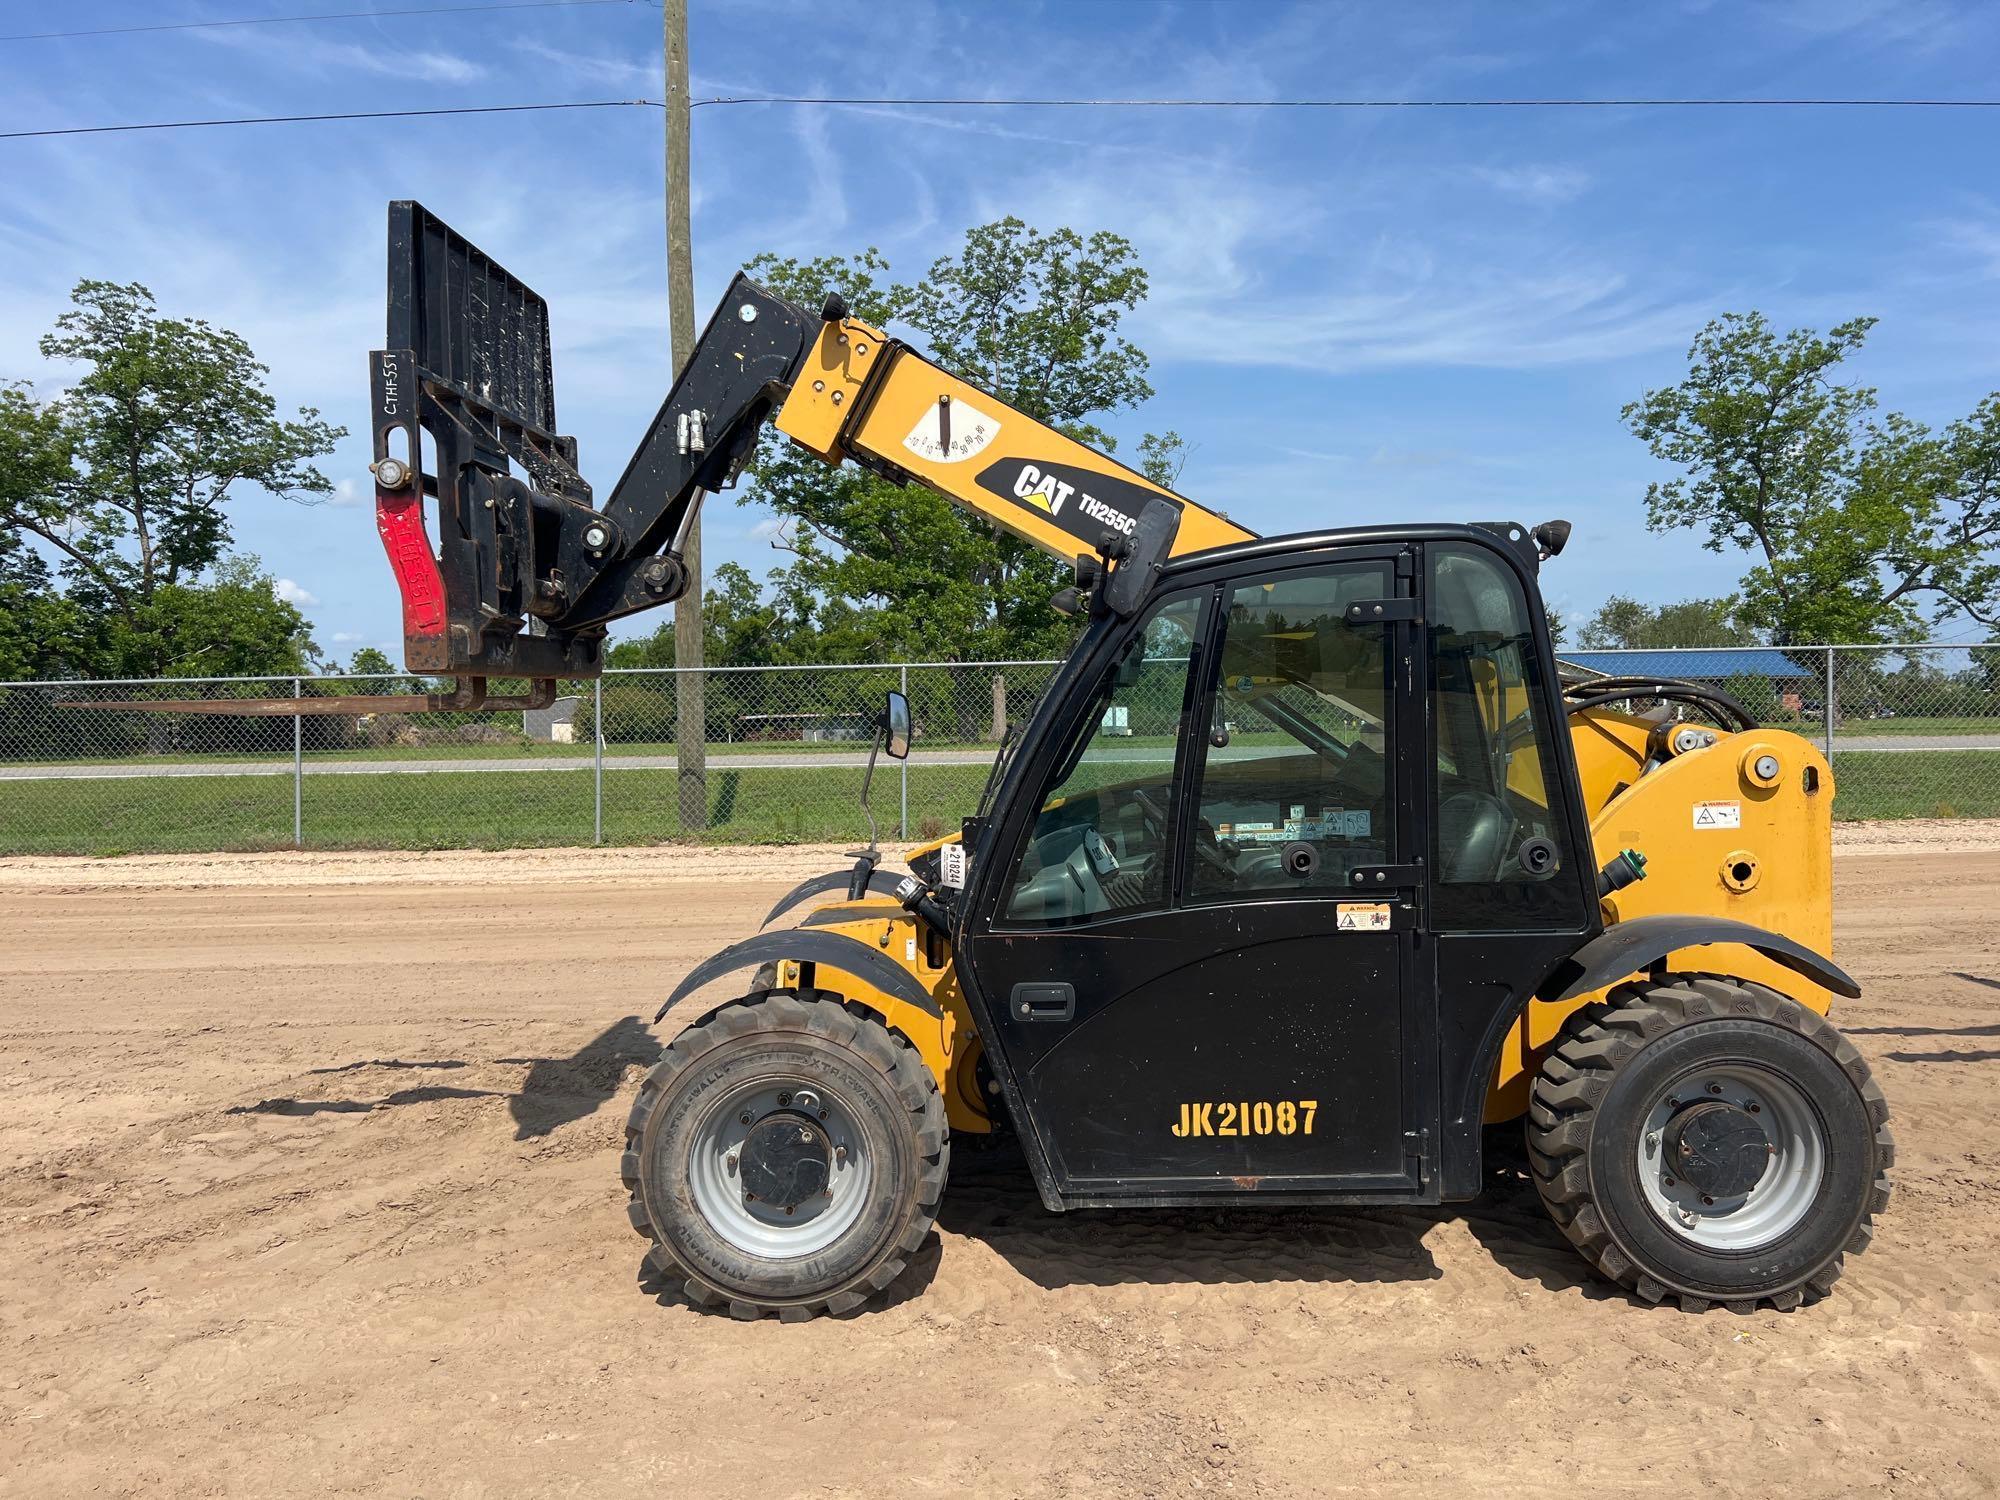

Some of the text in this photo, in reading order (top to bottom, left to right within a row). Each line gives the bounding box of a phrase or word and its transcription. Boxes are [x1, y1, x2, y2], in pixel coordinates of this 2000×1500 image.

[383, 353, 399, 415] CTHF551
[975, 424, 985, 435] 80
[951, 440, 959, 450] 40
[964, 434, 974, 446] 60
[974, 434, 984, 445] 70
[959, 444, 969, 455] 50
[1013, 464, 1137, 536] CAT TH255C
[949, 853, 961, 883] 218244
[1171, 1100, 1318, 1137] JK21087
